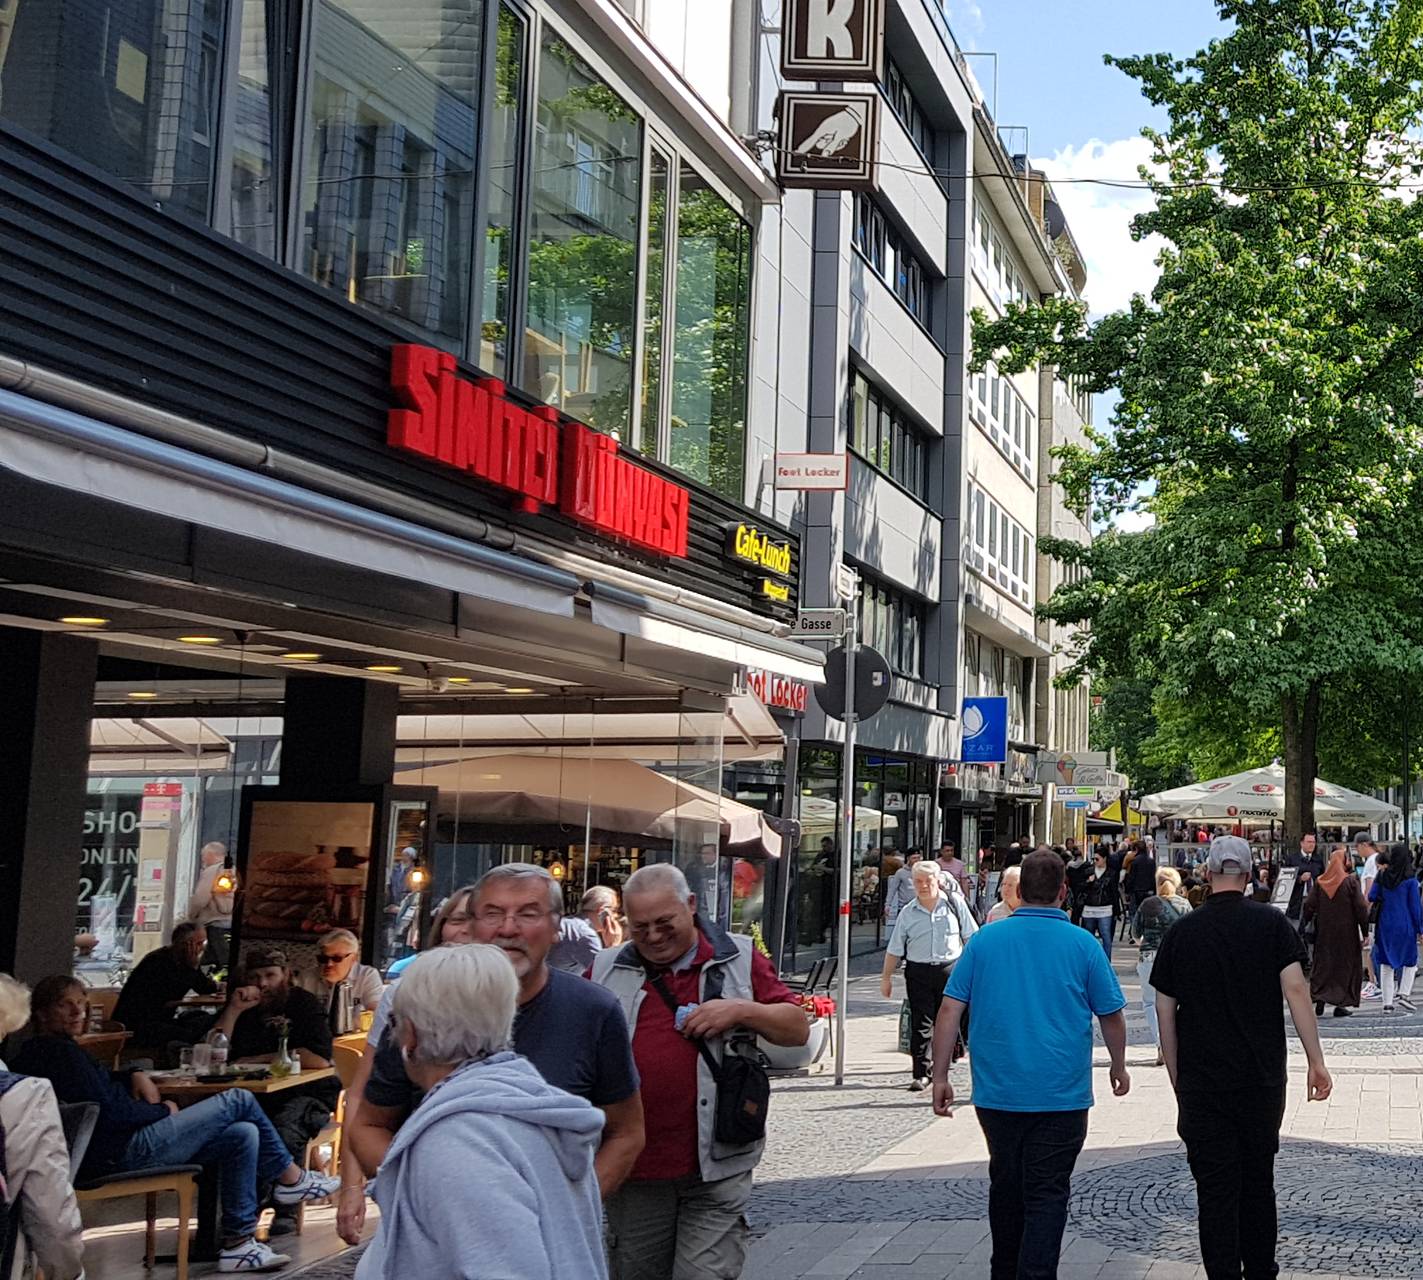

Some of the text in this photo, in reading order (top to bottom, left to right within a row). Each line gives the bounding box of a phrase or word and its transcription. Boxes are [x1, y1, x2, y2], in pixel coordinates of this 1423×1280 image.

[807, 0, 855, 58] K
[778, 467, 840, 477] Foot Locker
[735, 523, 791, 577] Cafe-Lunch
[801, 618, 832, 630] Gasse
[770, 673, 808, 713] Locker
[83, 811, 137, 834] SHO
[1240, 809, 1278, 817] mocambo
